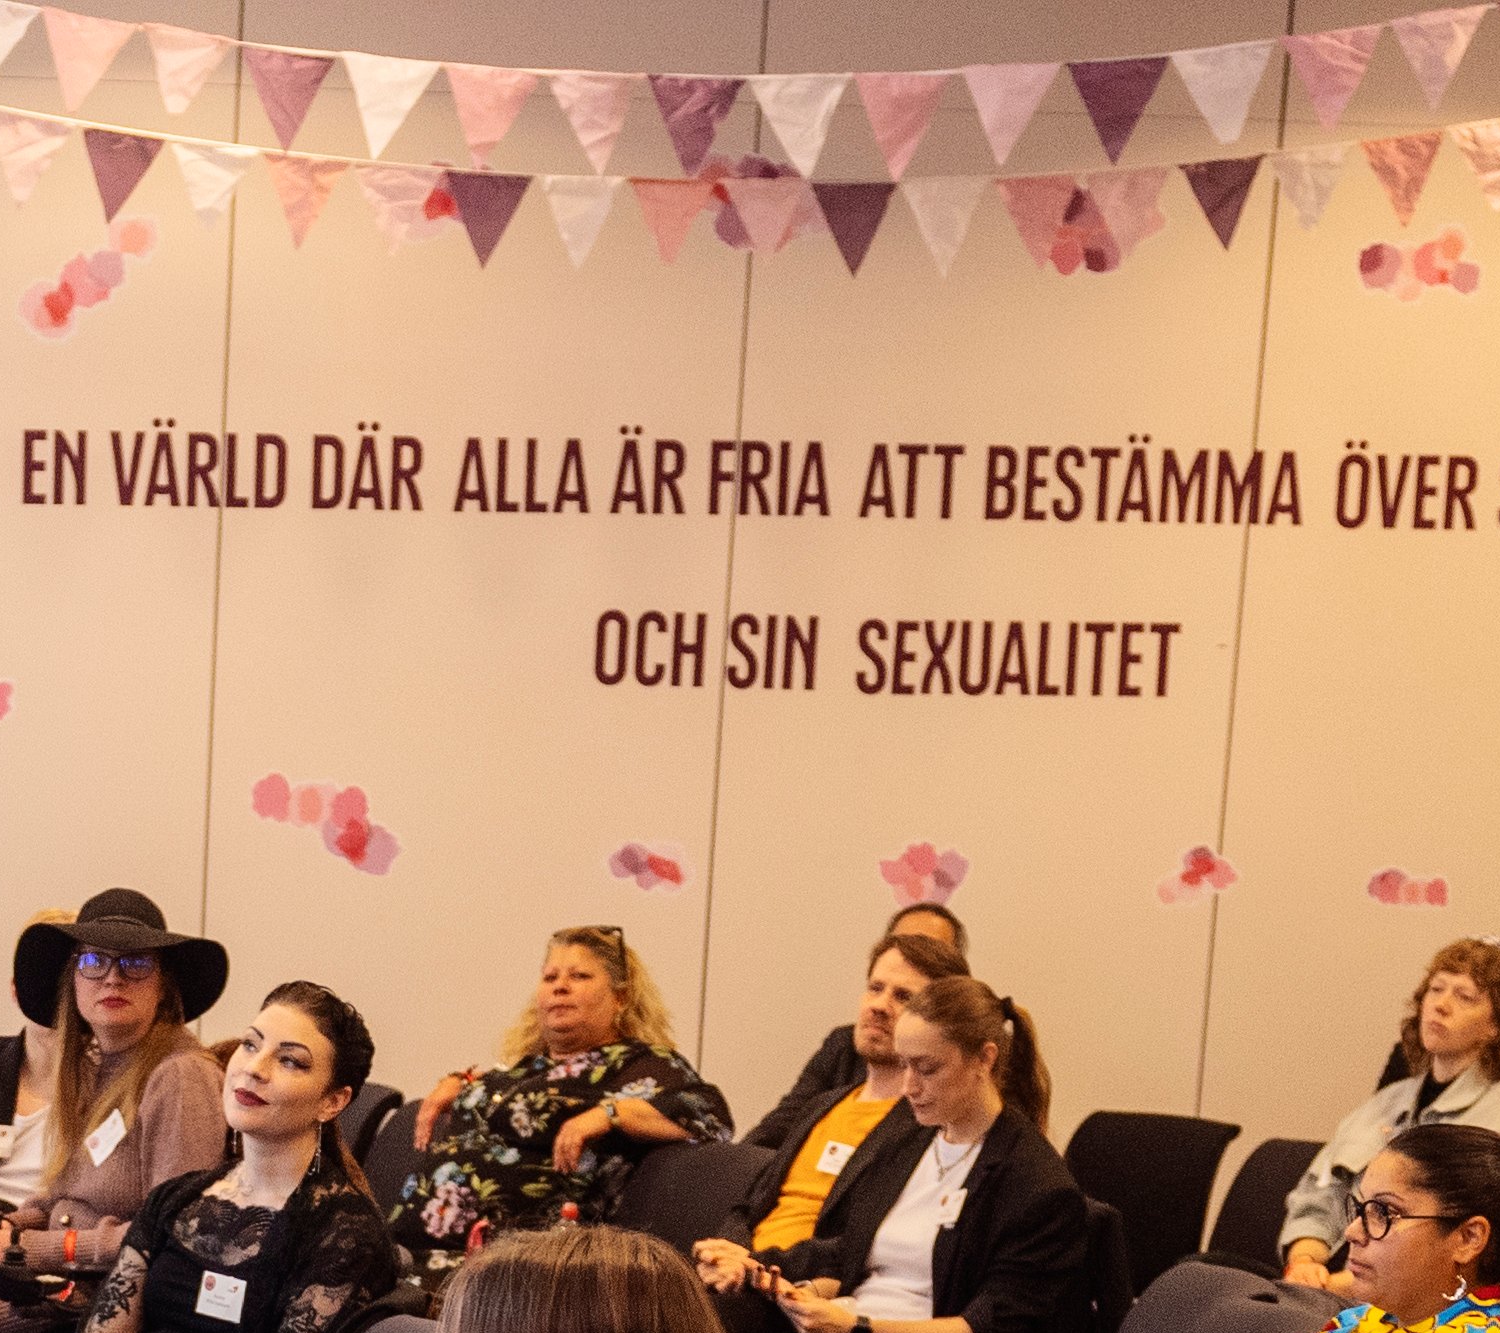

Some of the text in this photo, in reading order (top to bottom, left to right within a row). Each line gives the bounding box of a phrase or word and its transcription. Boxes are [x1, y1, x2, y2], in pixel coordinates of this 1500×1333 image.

[21, 428, 88, 507] EN
[109, 417, 288, 510] VÄRLD
[310, 421, 424, 513] DÄR
[452, 436, 591, 515] ALLA
[608, 424, 687, 516] ÄR
[707, 439, 832, 518] FRIA
[857, 442, 967, 521] ATT
[983, 433, 1302, 527] BESTÄMMA
[1334, 439, 1479, 531] ÖVER
[593, 609, 1182, 698] OCH SIN SEXUALITET
